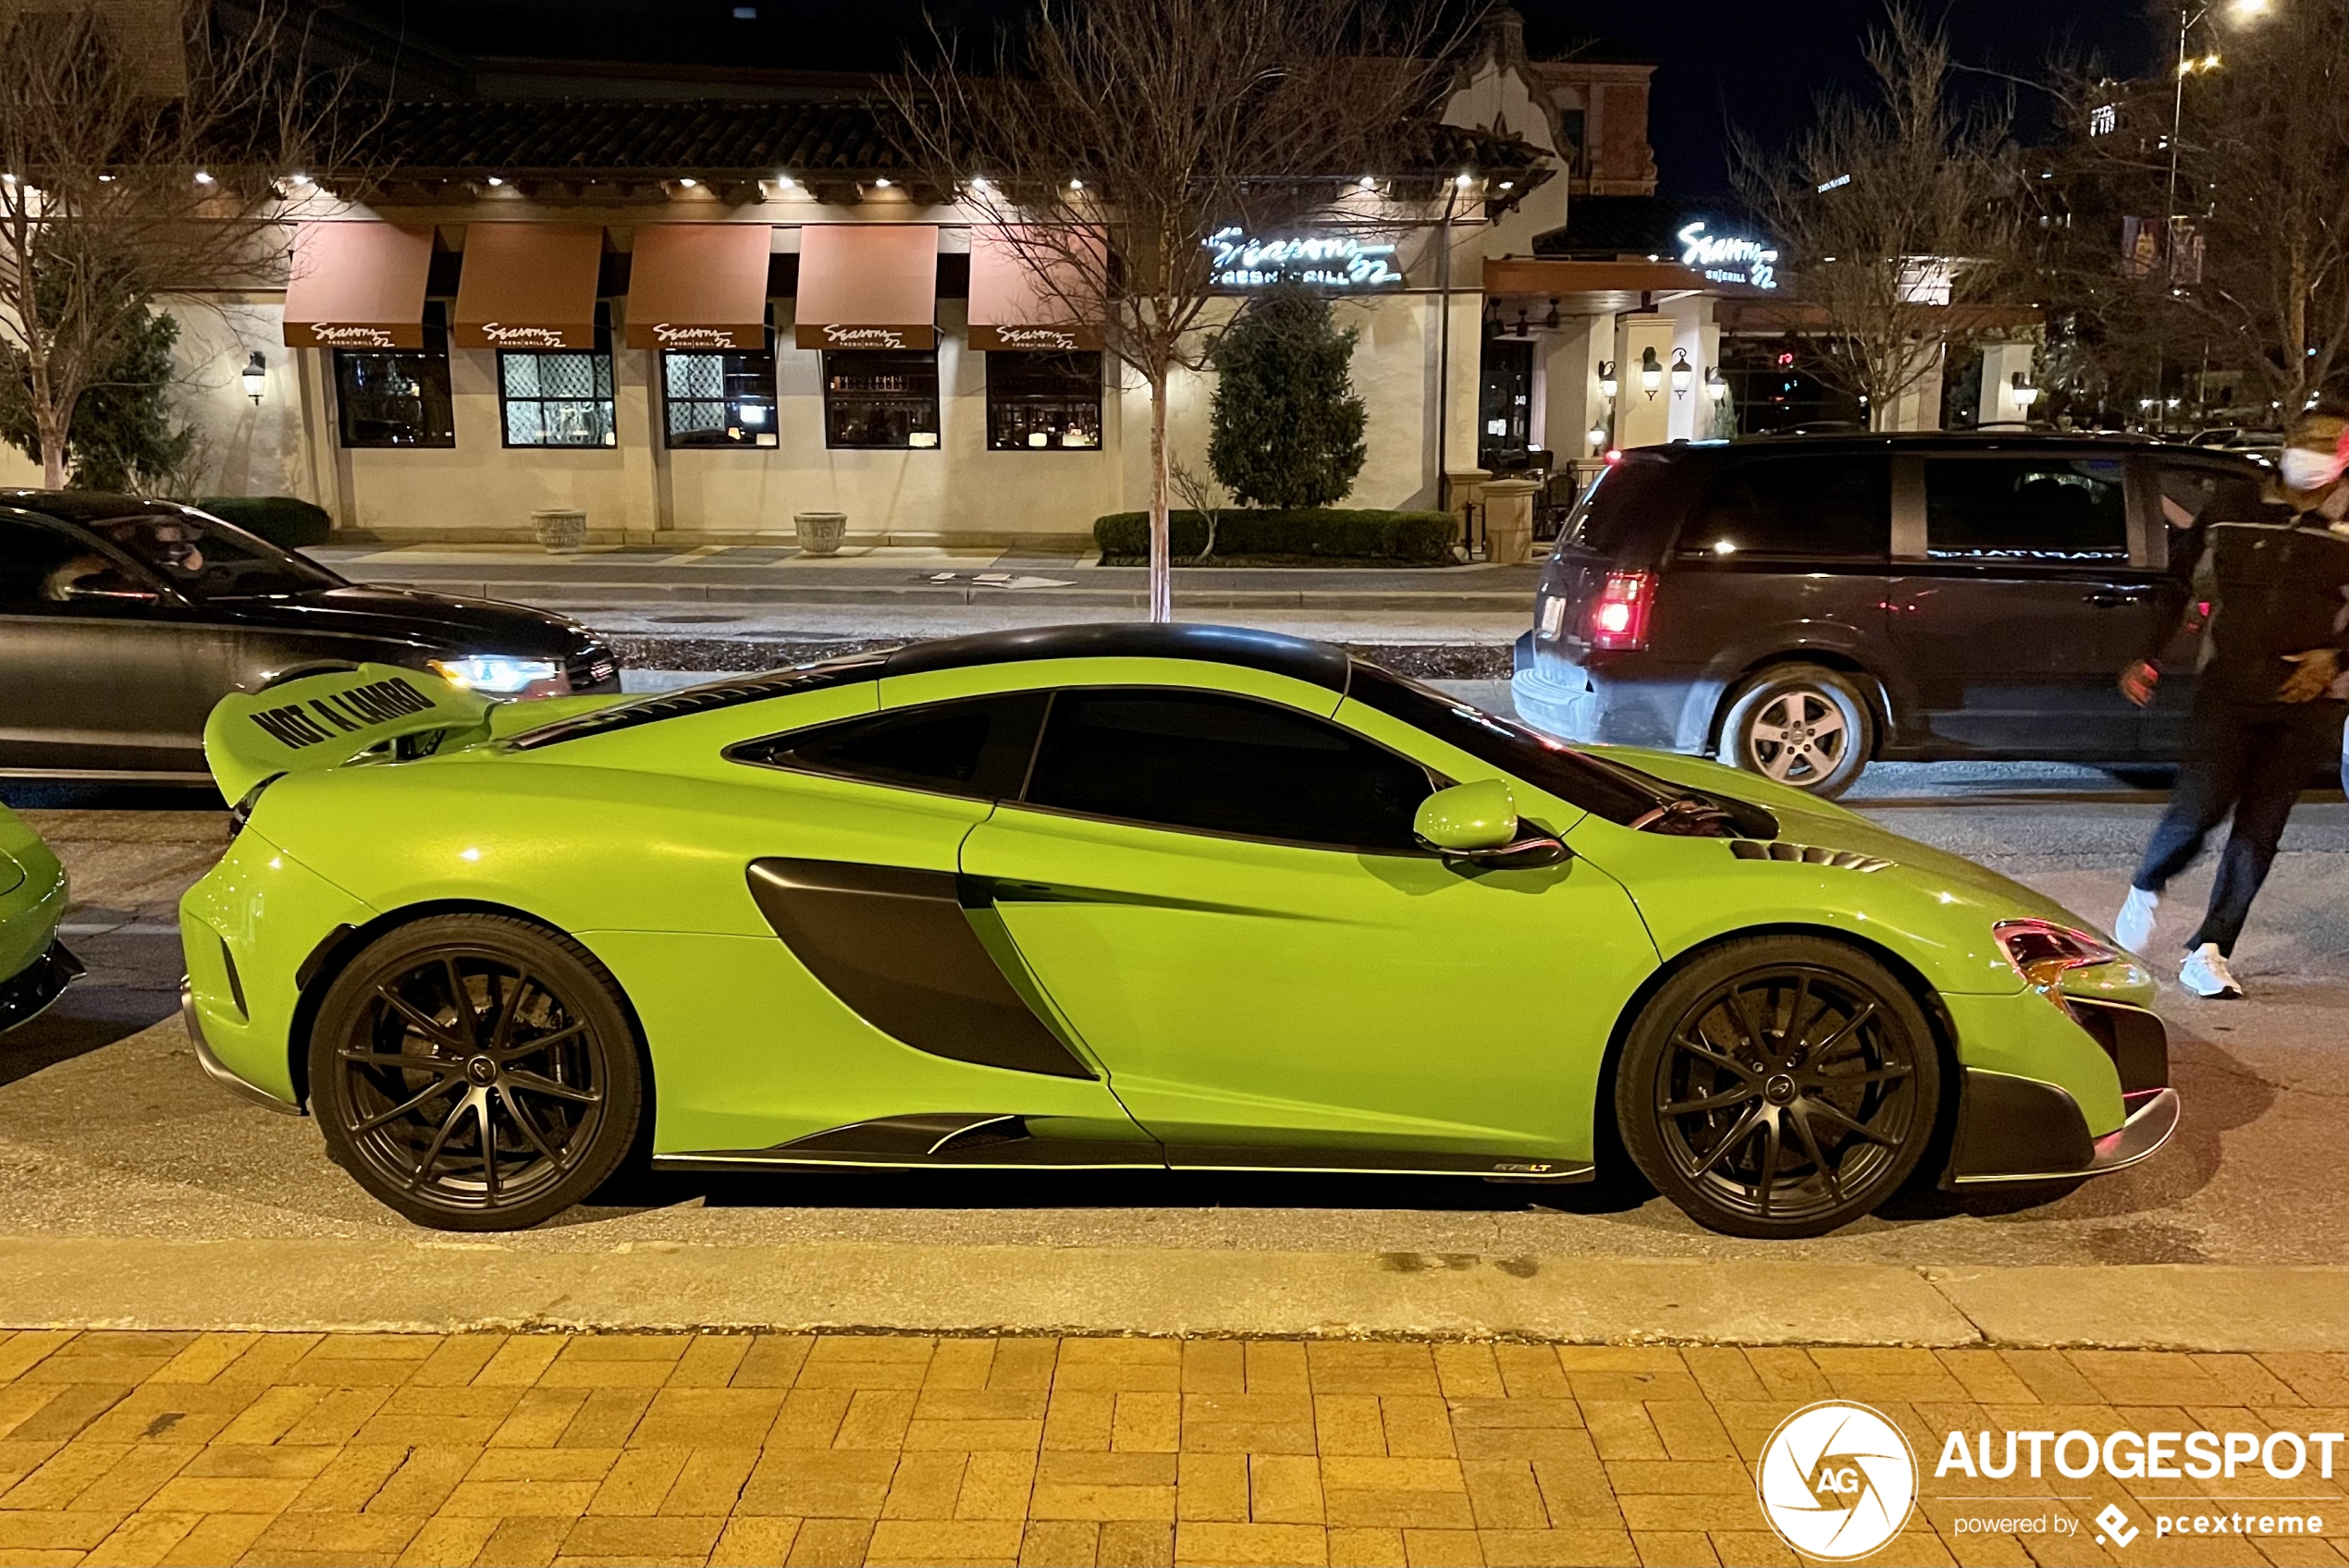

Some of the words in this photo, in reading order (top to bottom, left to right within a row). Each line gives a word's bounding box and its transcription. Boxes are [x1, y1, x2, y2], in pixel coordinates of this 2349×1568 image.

[1201, 227, 1396, 268] Seasons
[1347, 250, 1402, 284] 52
[1289, 270, 1349, 286] RILL
[311, 323, 391, 340] Seasons
[373, 334, 396, 348] 52
[482, 322, 563, 340] Seasons
[544, 334, 567, 348] 52
[653, 323, 733, 341] Seasons
[714, 335, 737, 349] 52
[823, 324, 904, 342] Seasons
[884, 336, 906, 349] 52
[996, 325, 1076, 343] Seasons
[328, 677, 437, 725] LAMBO
[248, 704, 338, 750] NOT
[307, 699, 363, 732] A
